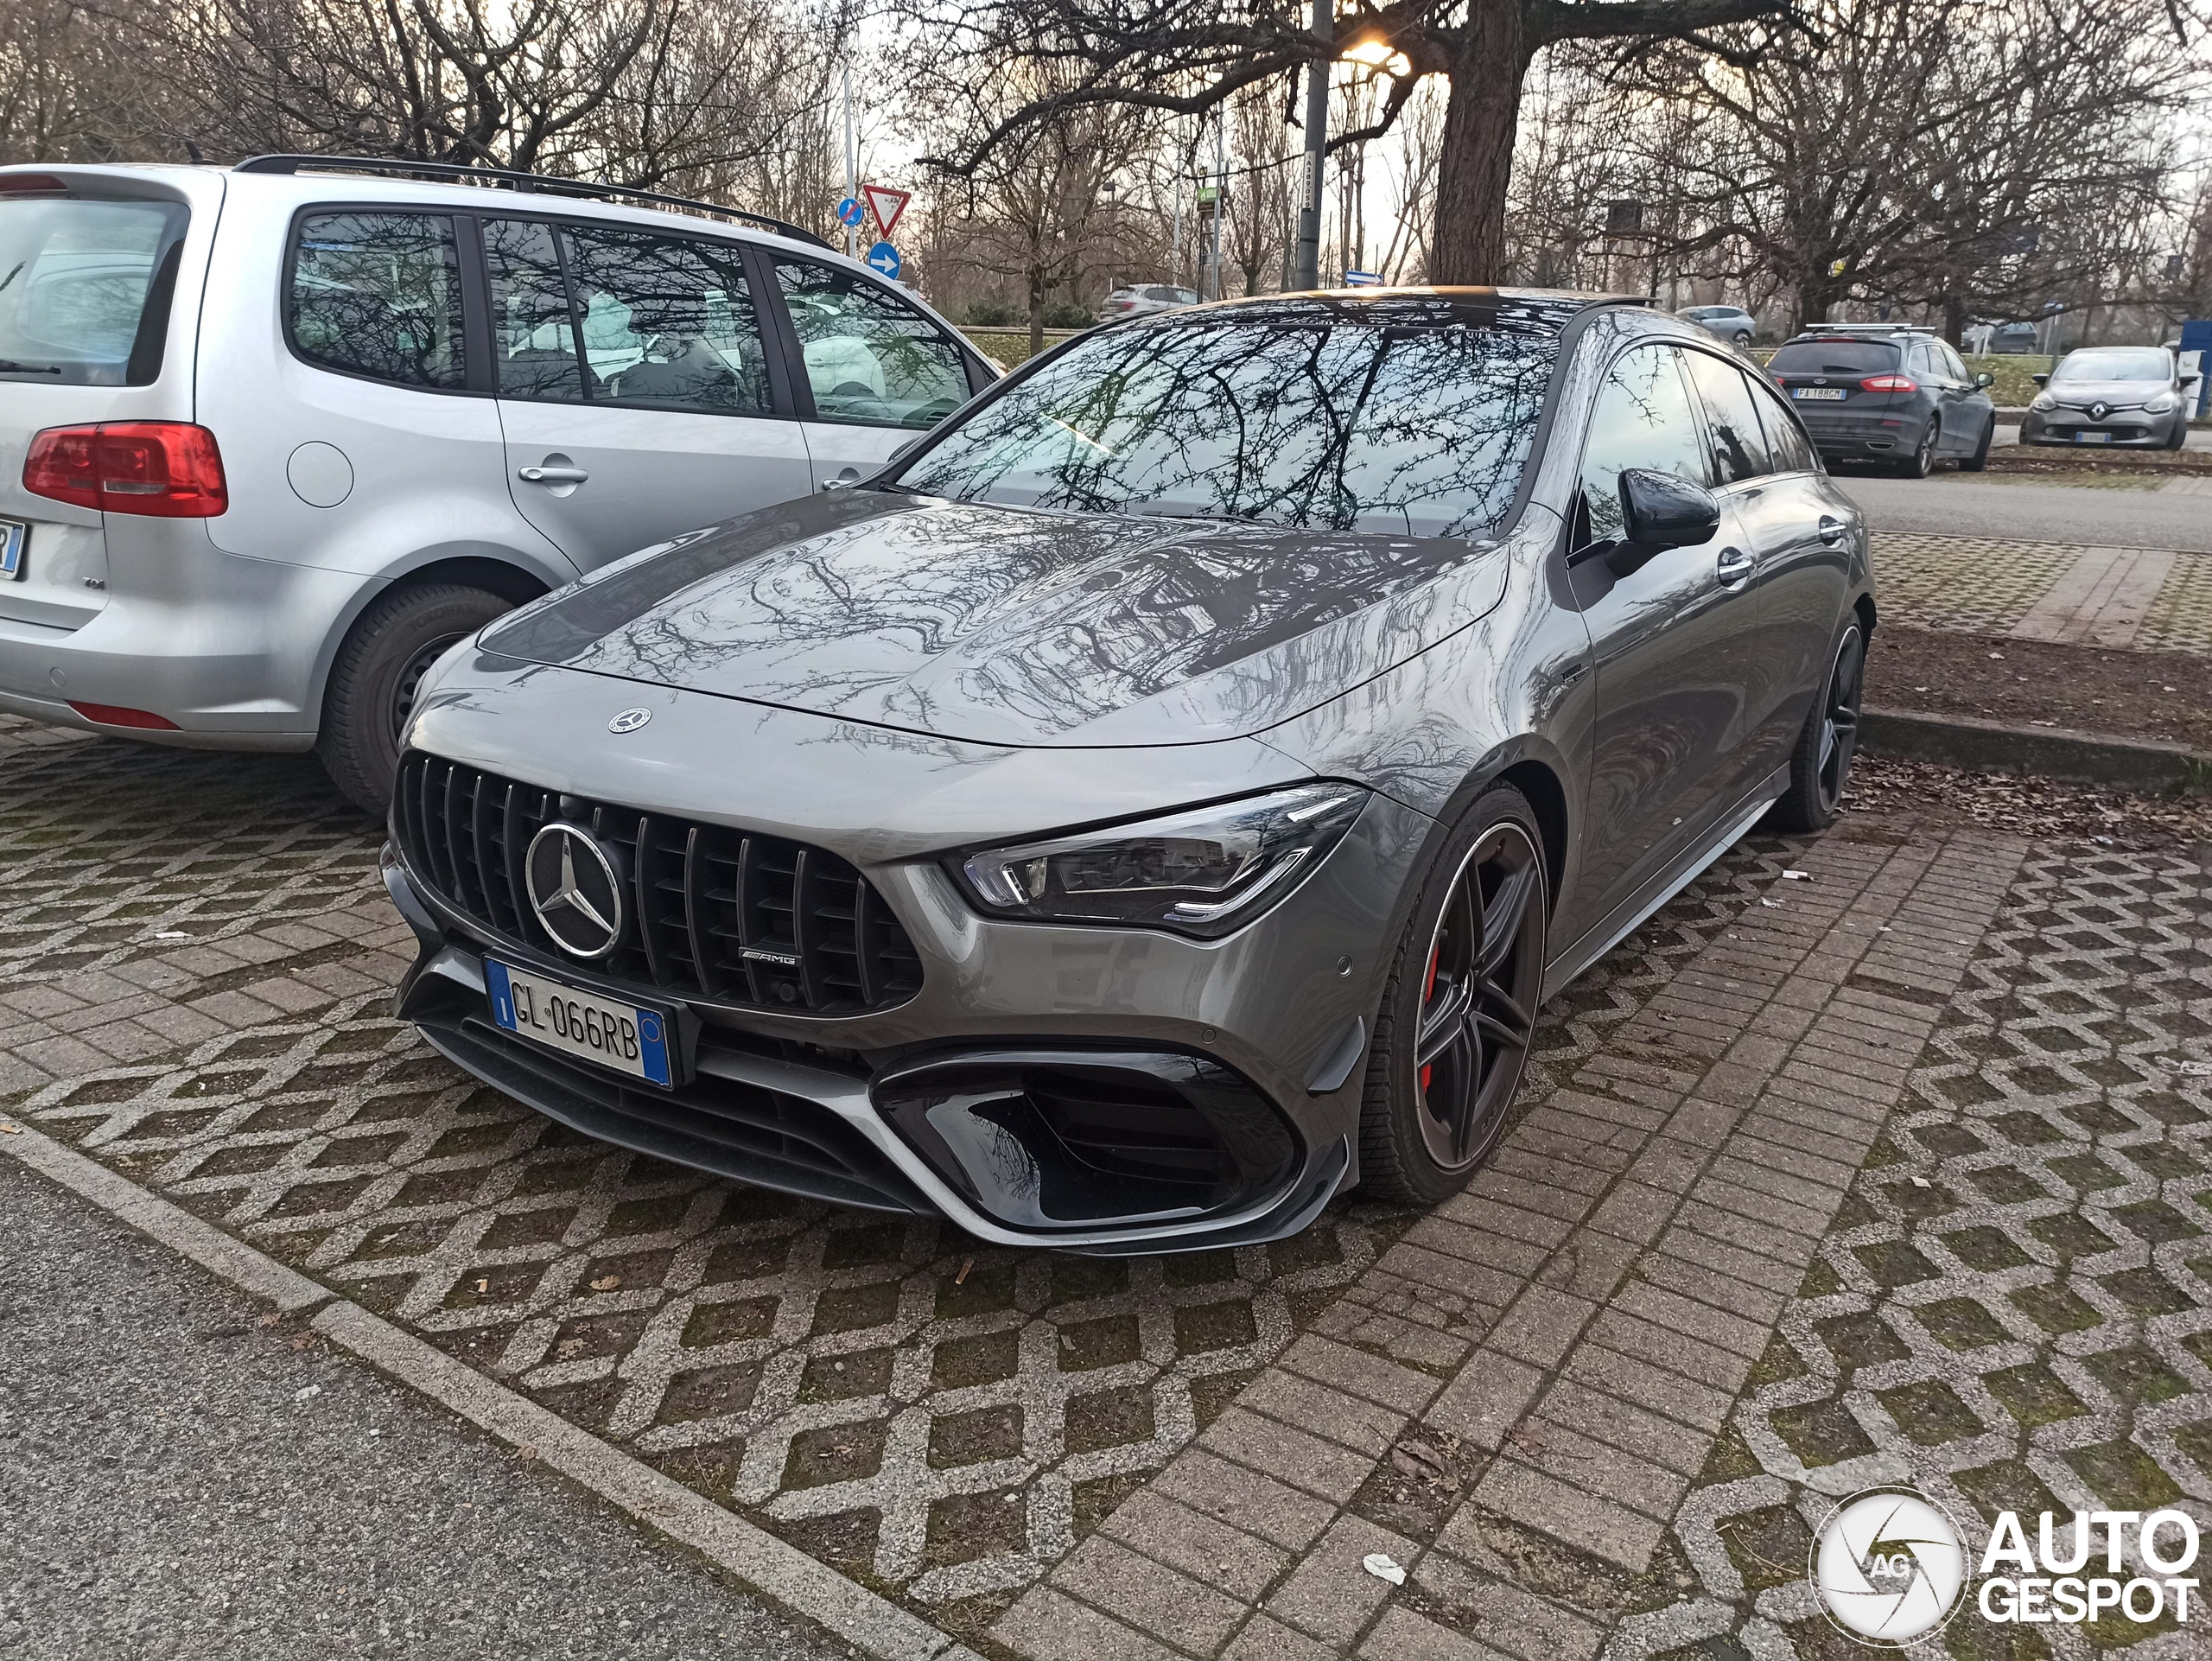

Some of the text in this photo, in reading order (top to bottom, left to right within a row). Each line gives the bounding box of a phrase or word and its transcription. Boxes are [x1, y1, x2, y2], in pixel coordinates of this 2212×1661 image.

[1799, 389, 1809, 398] FA
[759, 953, 796, 965] AMG
[511, 980, 639, 1060] GL 066RB
